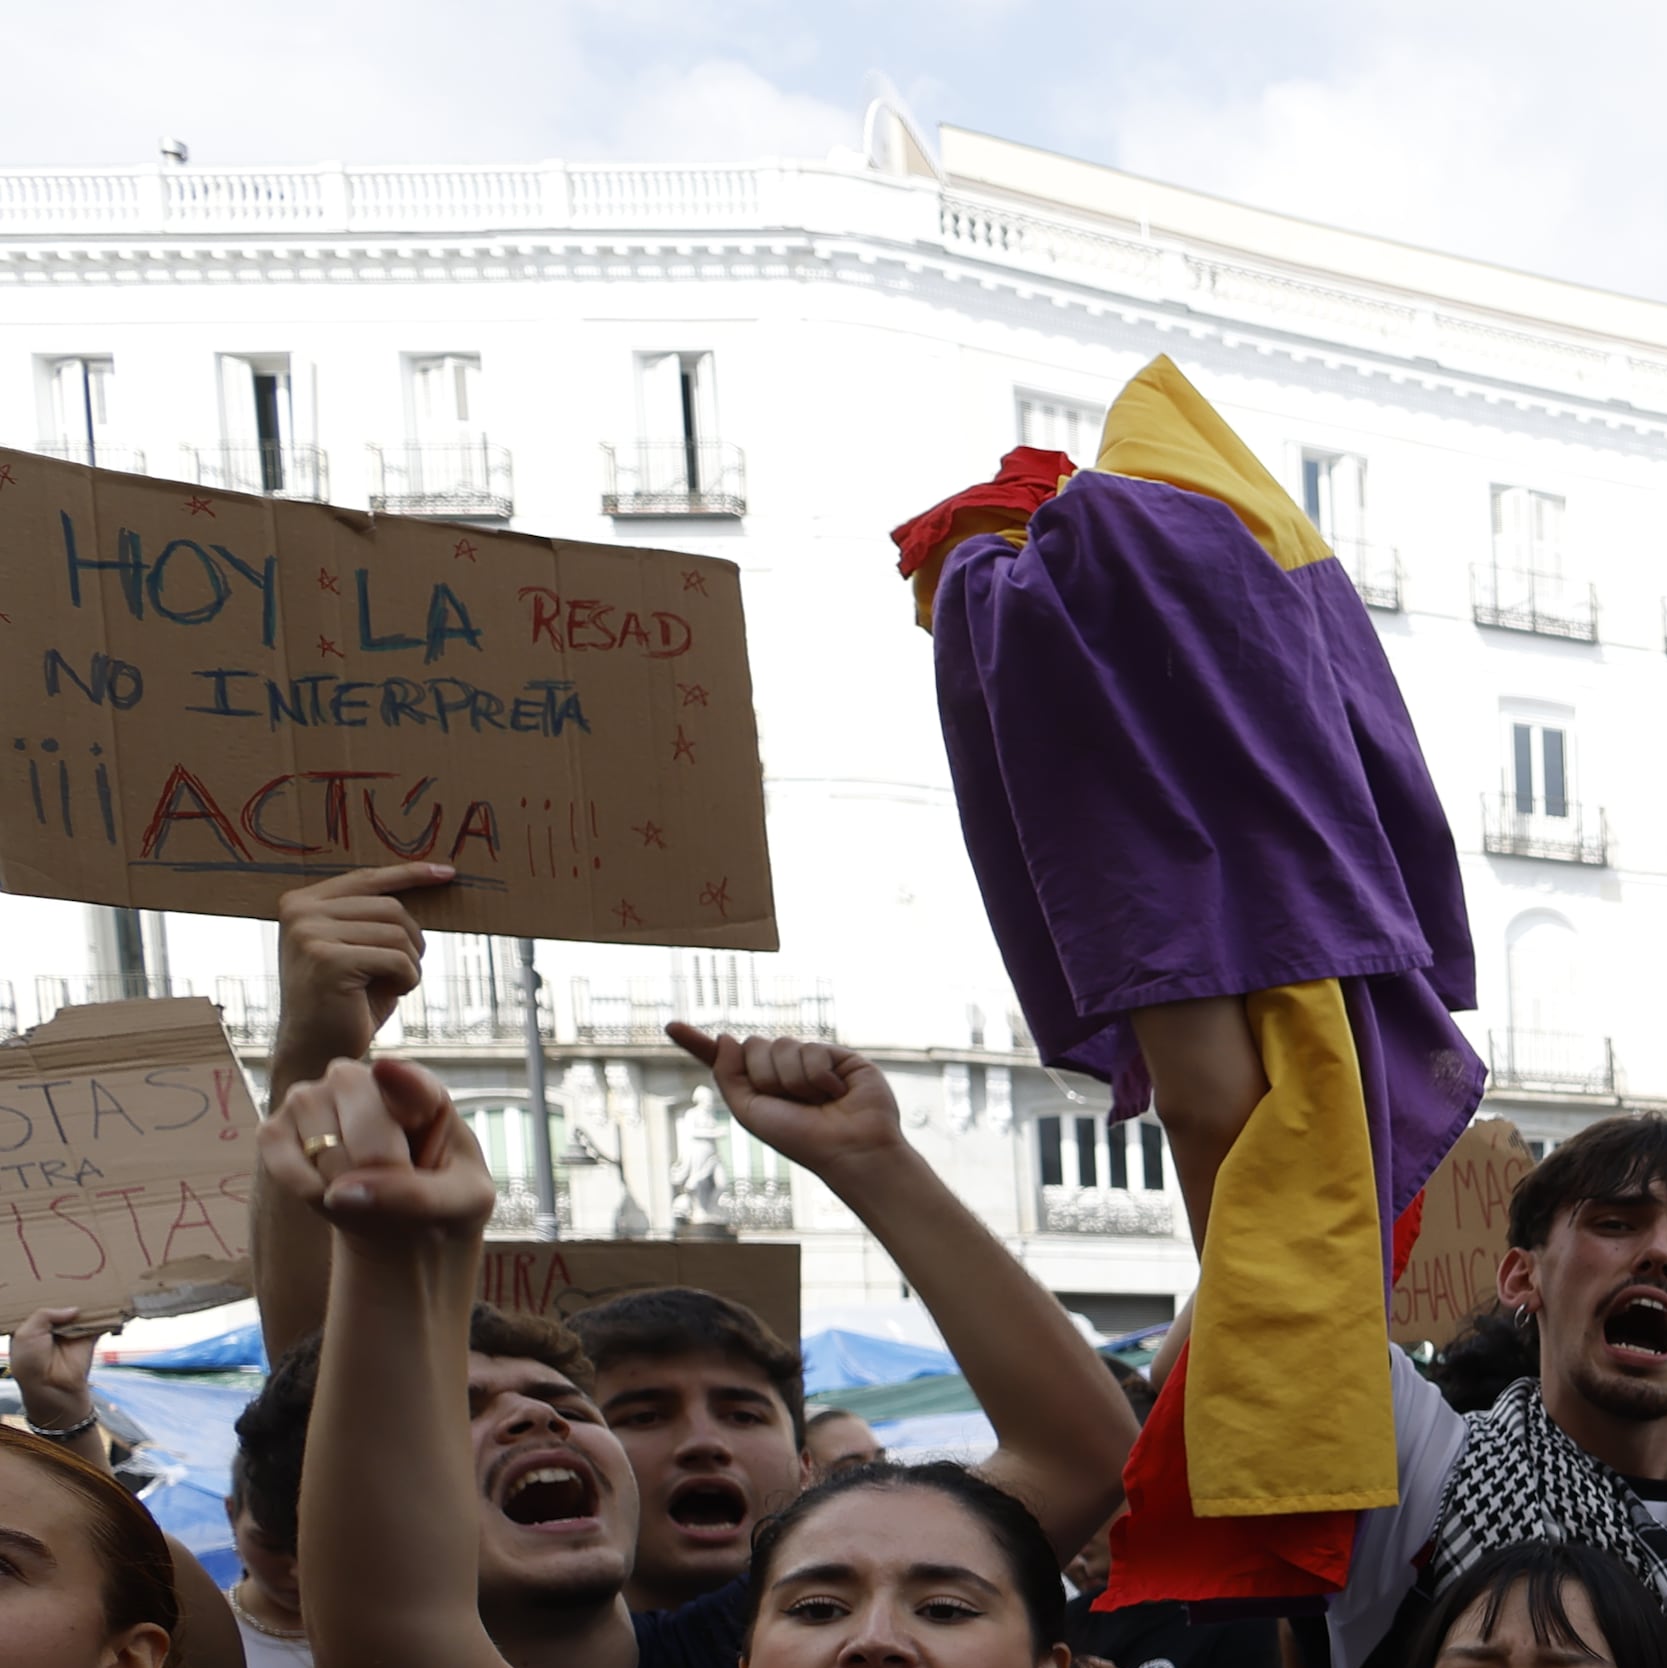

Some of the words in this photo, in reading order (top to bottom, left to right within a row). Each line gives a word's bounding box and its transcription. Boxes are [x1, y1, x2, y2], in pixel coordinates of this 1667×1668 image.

[60, 509, 276, 650] HOY
[357, 569, 484, 664] LA
[517, 586, 693, 658] RESAD
[46, 648, 143, 709] NO
[186, 667, 591, 734] INTERPRETA
